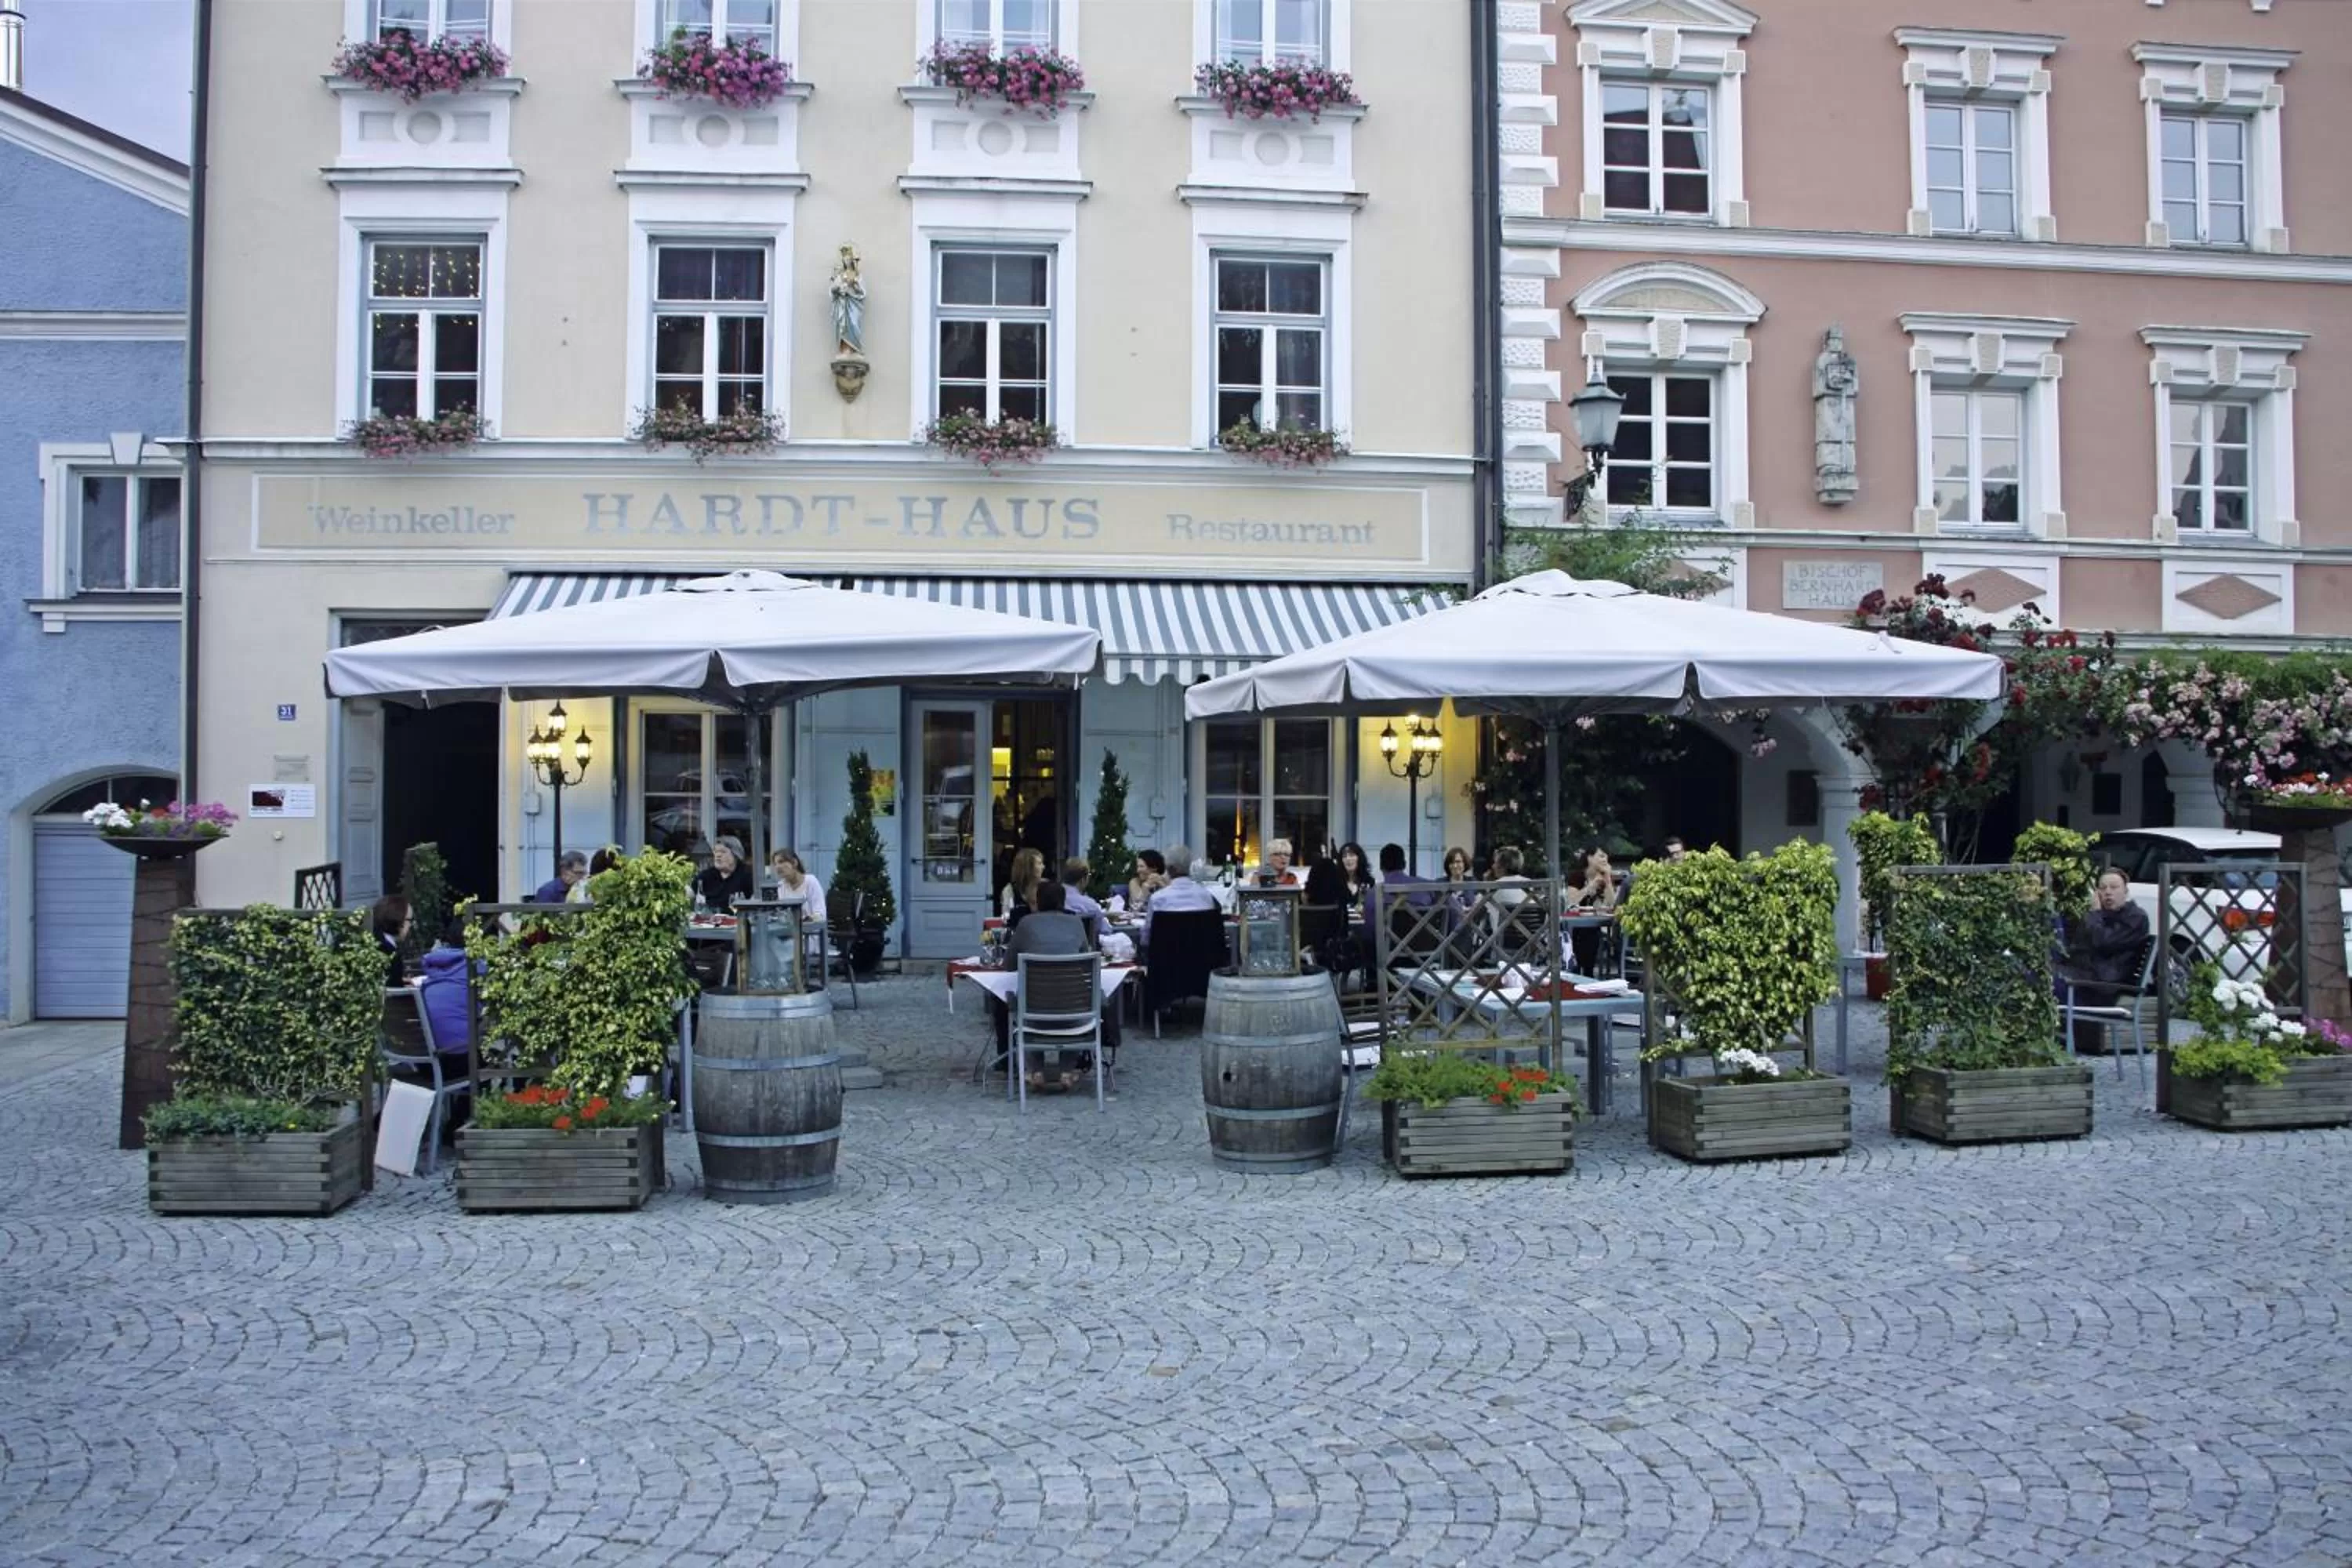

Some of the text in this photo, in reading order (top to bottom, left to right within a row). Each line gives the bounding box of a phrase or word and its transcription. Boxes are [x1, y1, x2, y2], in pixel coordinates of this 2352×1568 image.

[307, 492, 1377, 543] Weinkeller HARDT-HAUS Restaurant
[1798, 564, 1868, 578] BISCHOF
